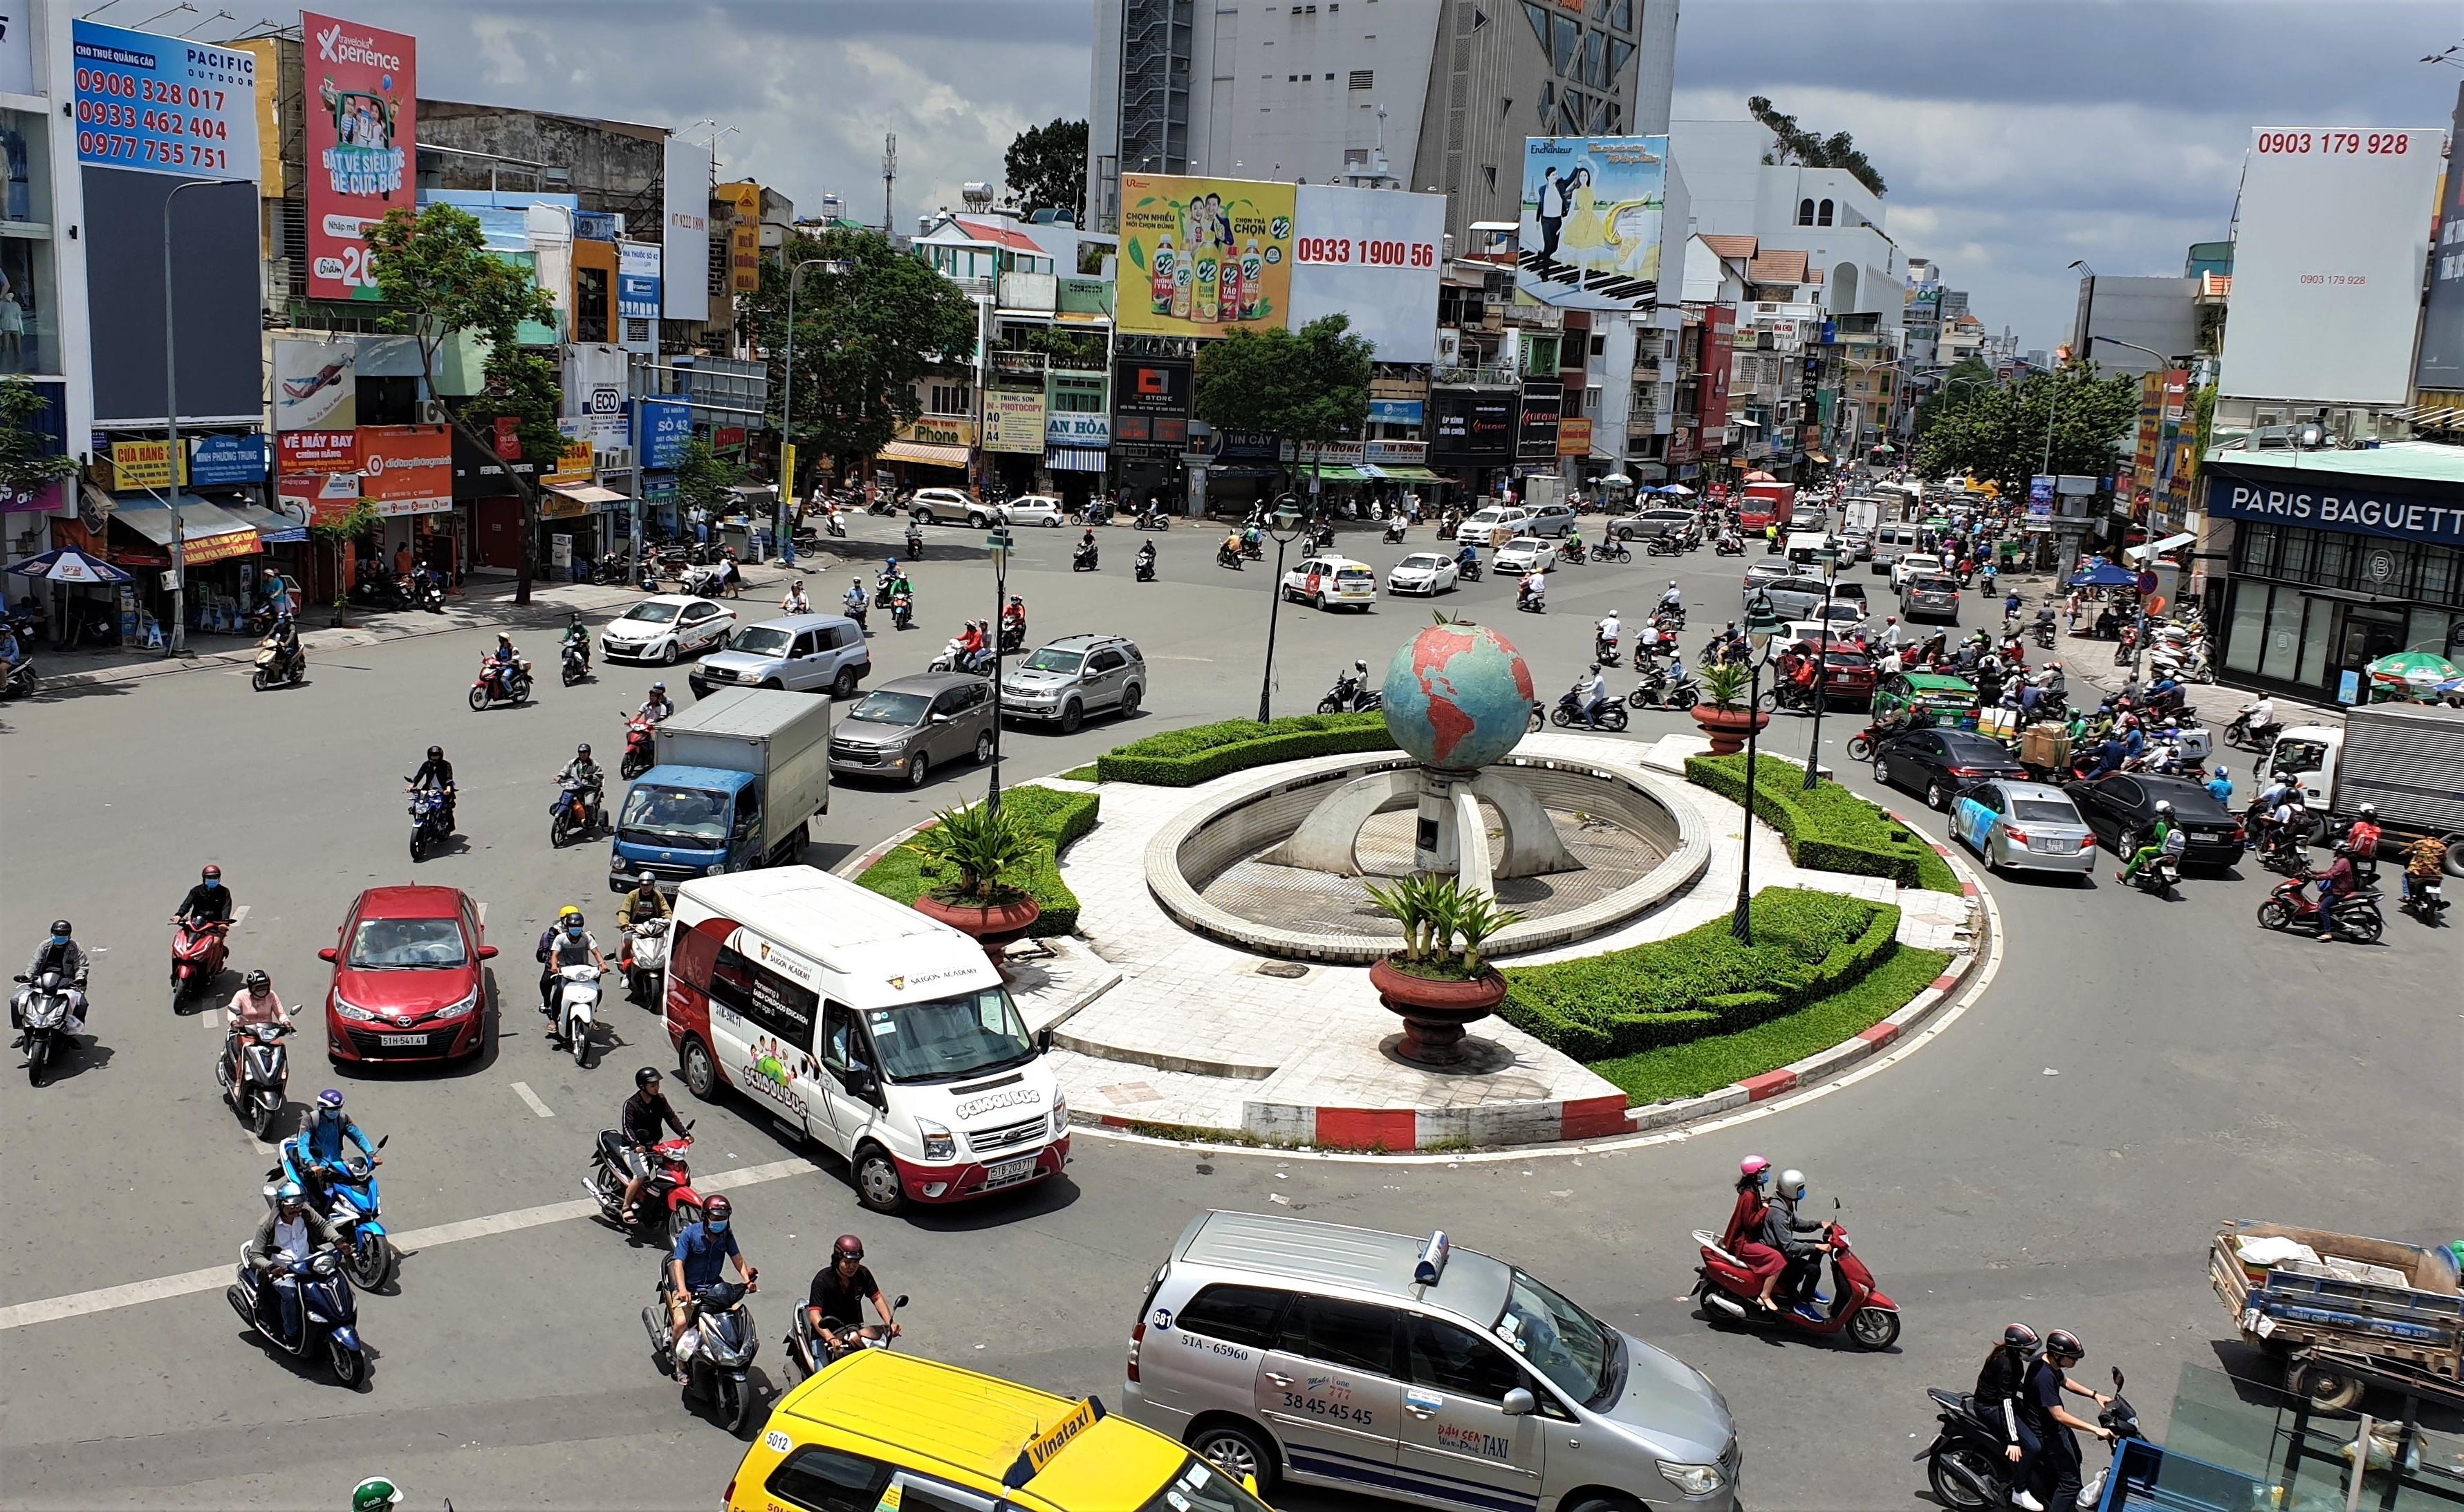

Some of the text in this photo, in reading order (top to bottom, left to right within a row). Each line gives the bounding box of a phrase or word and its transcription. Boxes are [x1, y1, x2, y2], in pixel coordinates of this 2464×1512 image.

[76, 45, 154, 67] CHO THUÊ QUẢNG CÁO
[187, 48, 253, 74] PACIFIC
[188, 68, 253, 87] OUTDOOR
[76, 67, 226, 111] 0908 328 017
[78, 100, 227, 140] 0933 462 404
[79, 131, 226, 170] 0977 755 751
[2258, 133, 2408, 155] 0903 179 928
[671, 213, 704, 231] 07 9222 1898
[1126, 212, 1149, 223] CHỌN
[328, 221, 345, 233] Nhập
[1234, 218, 1290, 239] CHỌN C2
[1298, 237, 1434, 268] 0933 1900 56
[319, 258, 342, 274] Giảm
[1155, 256, 1174, 274] C2
[1196, 261, 1218, 283] C2
[1243, 261, 1261, 280] C2
[1177, 271, 1193, 286] C2
[1222, 267, 1238, 285] C2
[2300, 275, 2366, 285] 0903 179 928
[1803, 388, 1815, 396] 0%
[595, 393, 615, 411] ECO
[1000, 404, 1042, 412] PHOTOCOPY
[658, 417, 688, 432] SỐ 42
[986, 412, 999, 422] A0
[915, 425, 958, 442] iPhone
[1048, 420, 1071, 433] AN
[1075, 419, 1109, 435] HÒA
[283, 433, 353, 449] VÉ MÁY BAY
[985, 431, 999, 442] A4
[118, 443, 164, 463] CỬA HÀNG
[2231, 487, 2312, 518] PARIS
[770, 955, 810, 981] SAIGON ACADEMY
[910, 968, 977, 985] SAIGON ACADEMY
[754, 979, 777, 998] Pioneering
[752, 998, 771, 1015] from age
[753, 988, 808, 1025] EARLY CHILDHOOD EDUCATION
[743, 1065, 808, 1121] SCHOOL BUS
[956, 1090, 1040, 1120] SCHOOL BUS
[1154, 1311, 1172, 1327] 681
[1181, 1334, 1203, 1350] 51A
[1213, 1343, 1248, 1361] 65960
[1328, 1385, 1352, 1400] 777
[1283, 1392, 1373, 1426] 38 45 45 45
[766, 1432, 788, 1450] 5012
[1461, 1429, 1481, 1444] SEN
[1483, 1434, 1509, 1459] TAXI
